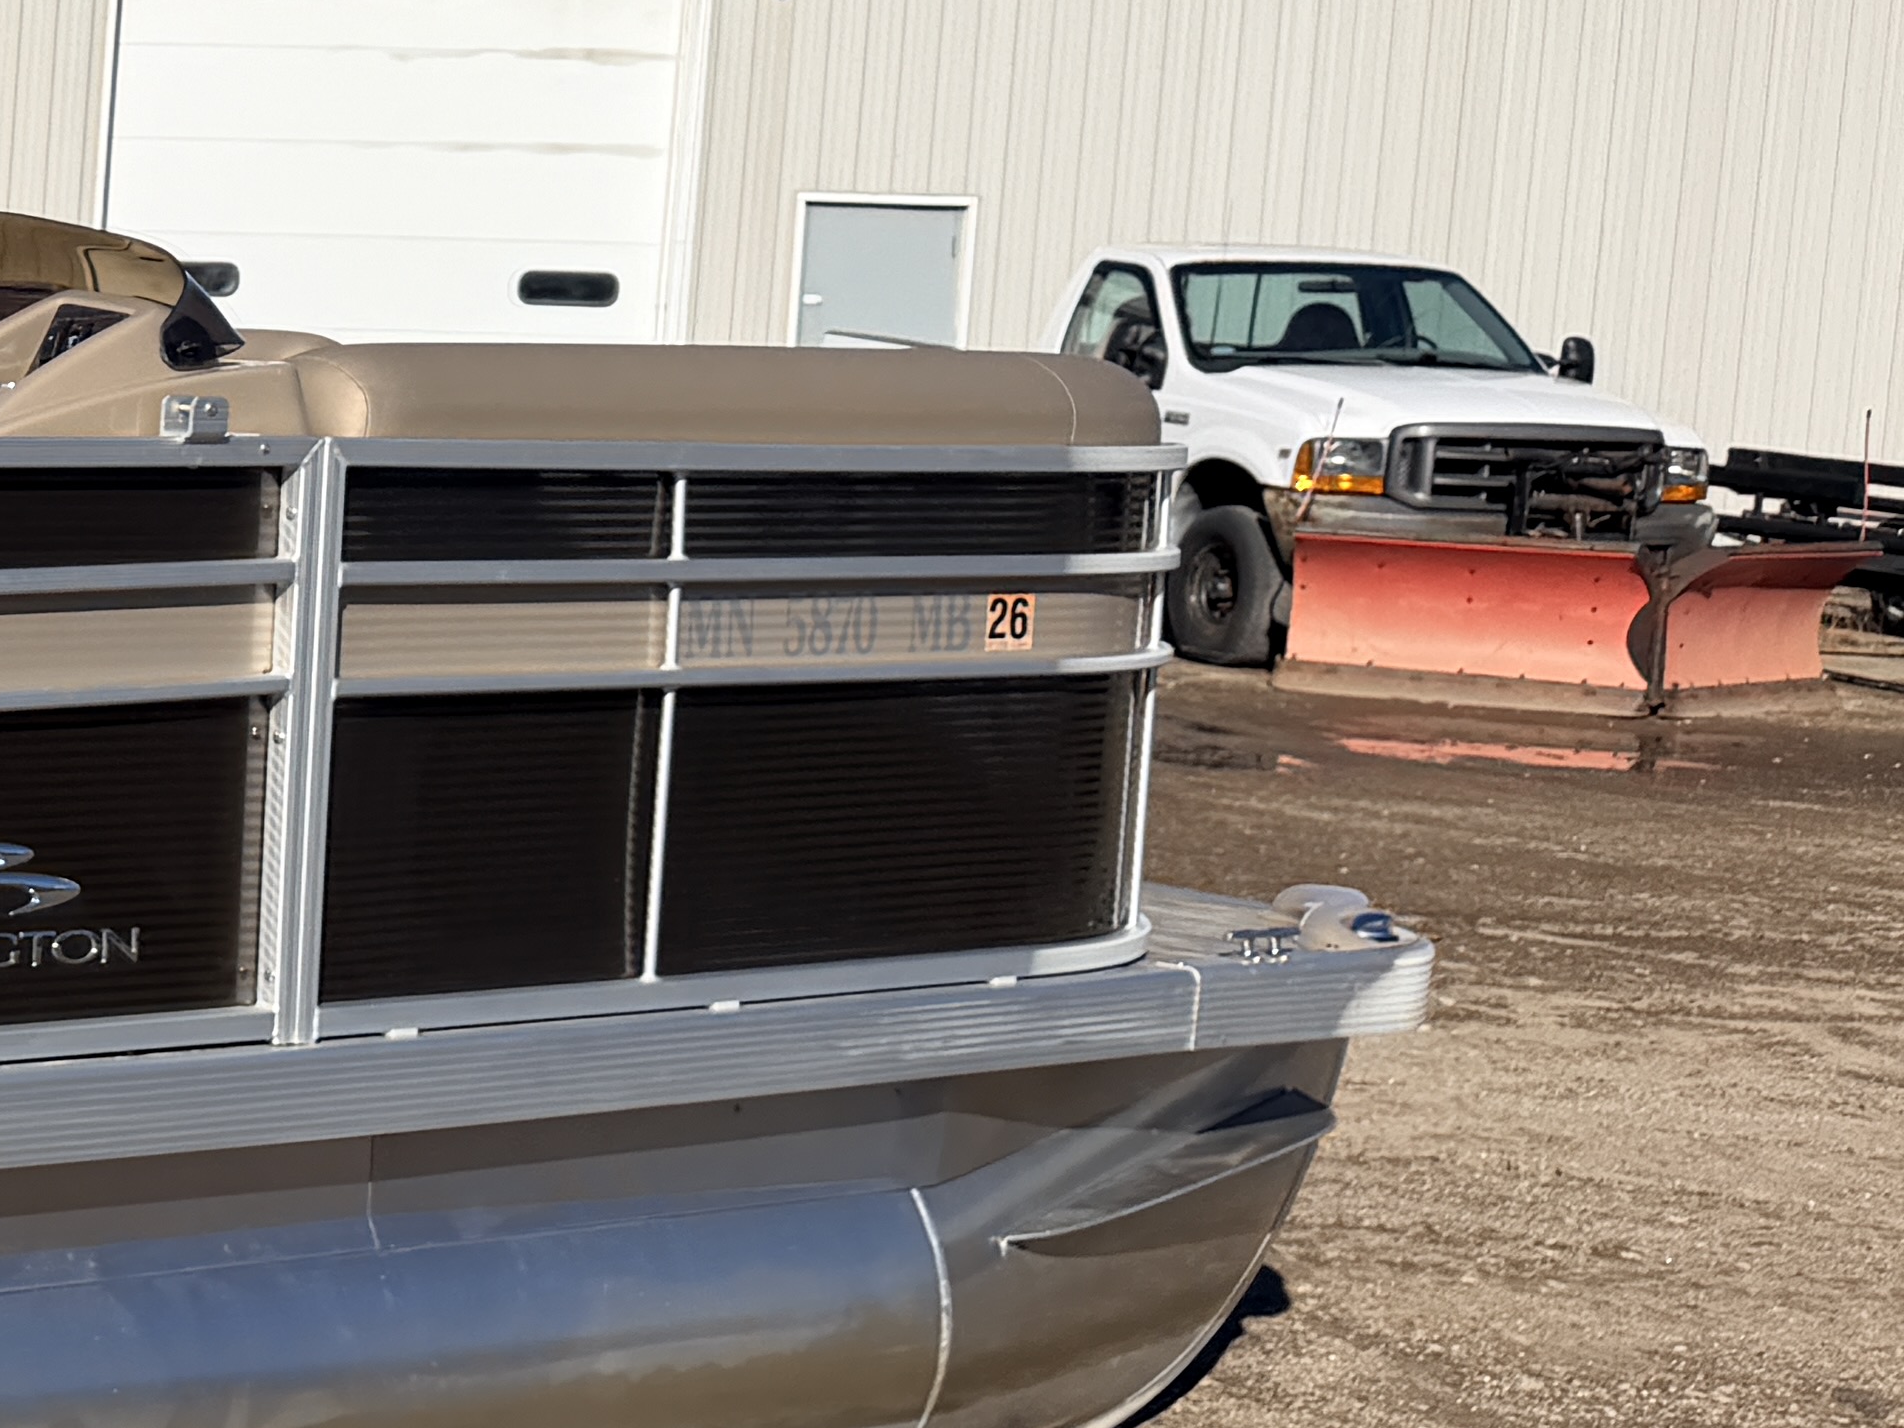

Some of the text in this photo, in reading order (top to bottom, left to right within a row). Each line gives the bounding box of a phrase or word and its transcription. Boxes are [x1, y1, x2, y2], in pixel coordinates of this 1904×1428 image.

[685, 589, 973, 660] MN 5870 MB
[988, 597, 1029, 640] 26
